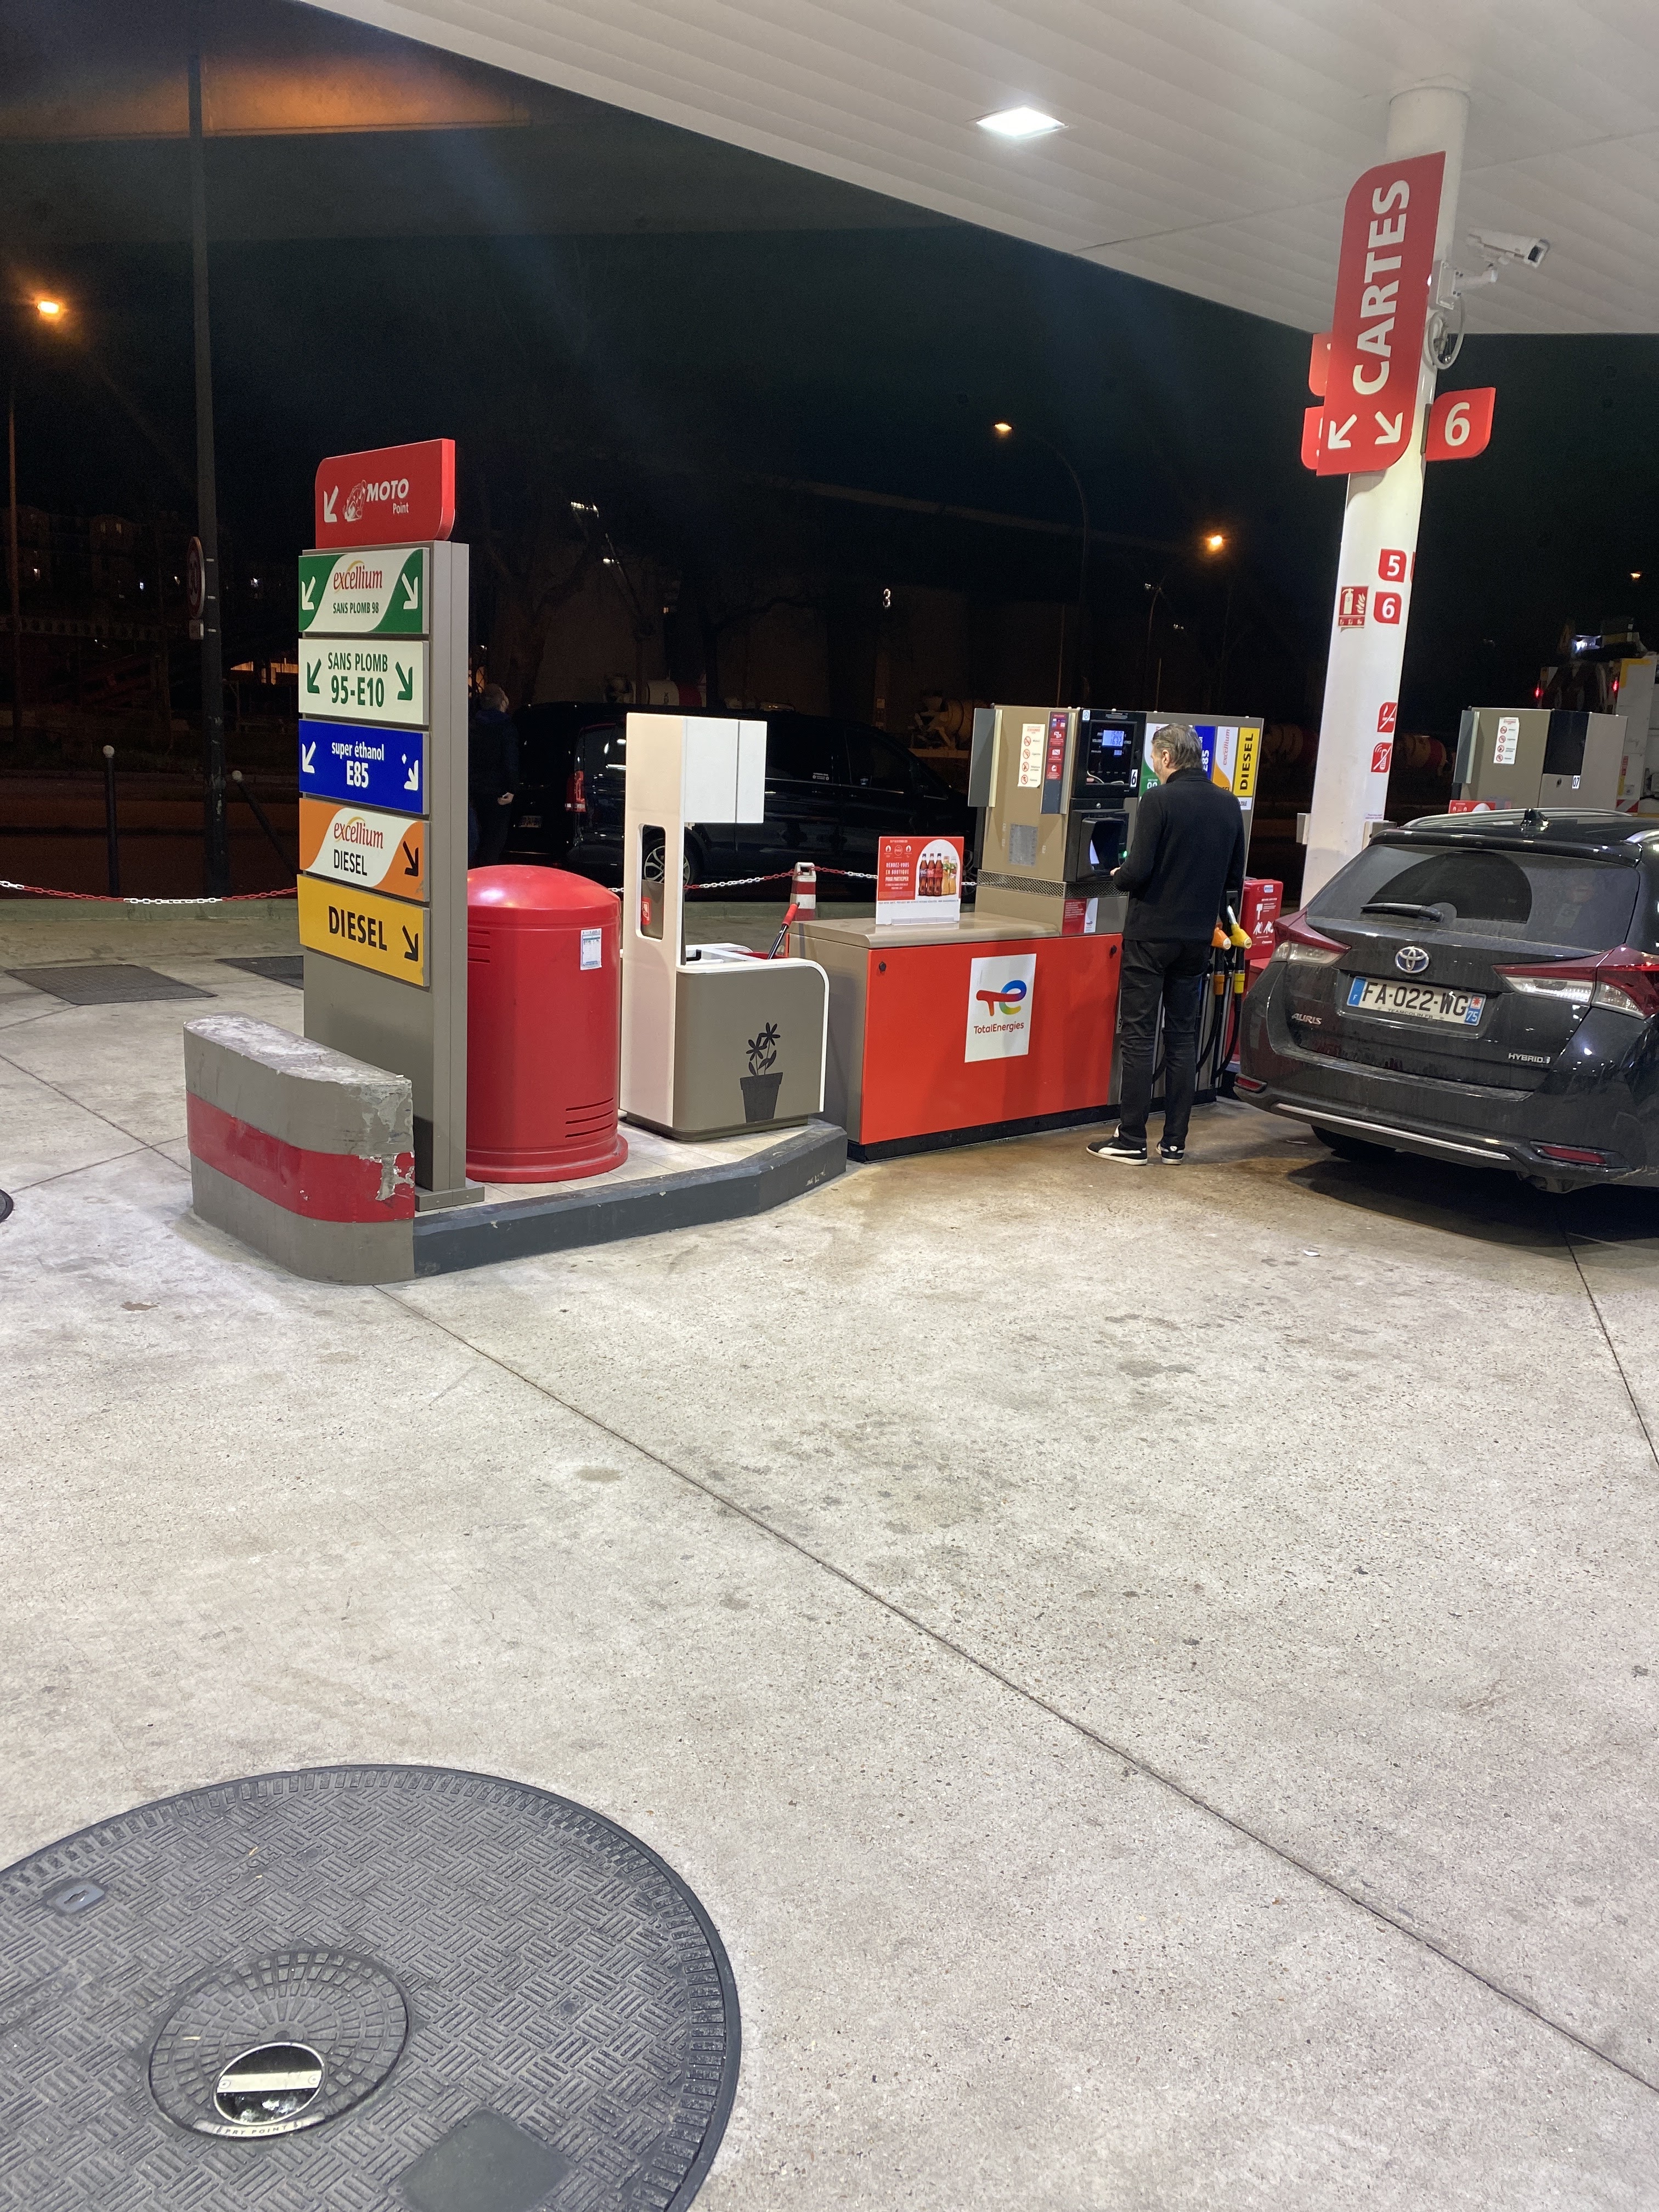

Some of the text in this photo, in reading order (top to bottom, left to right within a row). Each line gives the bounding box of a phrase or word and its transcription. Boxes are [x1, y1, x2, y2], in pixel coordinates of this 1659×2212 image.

[1352, 179, 1410, 395] CARTES
[1444, 402, 1471, 447] 6
[366, 478, 409, 501] MOTO
[392, 502, 409, 515] Point
[1387, 555, 1401, 577] 5
[333, 563, 383, 593] excellium
[332, 602, 379, 614] SANS PLOMB 98
[1382, 597, 1395, 619] 6
[328, 652, 388, 673] SANS PLOMB
[331, 675, 385, 708] 95-E10
[331, 741, 384, 761] super éthanol
[1239, 733, 1254, 790] DIESEL
[346, 760, 369, 788] E85
[1132, 771, 1136, 785] 6
[1573, 776, 1579, 788] 07
[334, 821, 383, 849] excellium
[334, 849, 368, 876] DIESEL
[328, 905, 387, 951] DIESEL
[1362, 981, 1469, 1017] FA-022-WG
[1291, 1013, 1322, 1025] AURIS
[1465, 1010, 1478, 1022] 75
[974, 1021, 1024, 1034] TotalEnergies
[1508, 1053, 1544, 1063] HYBRID
